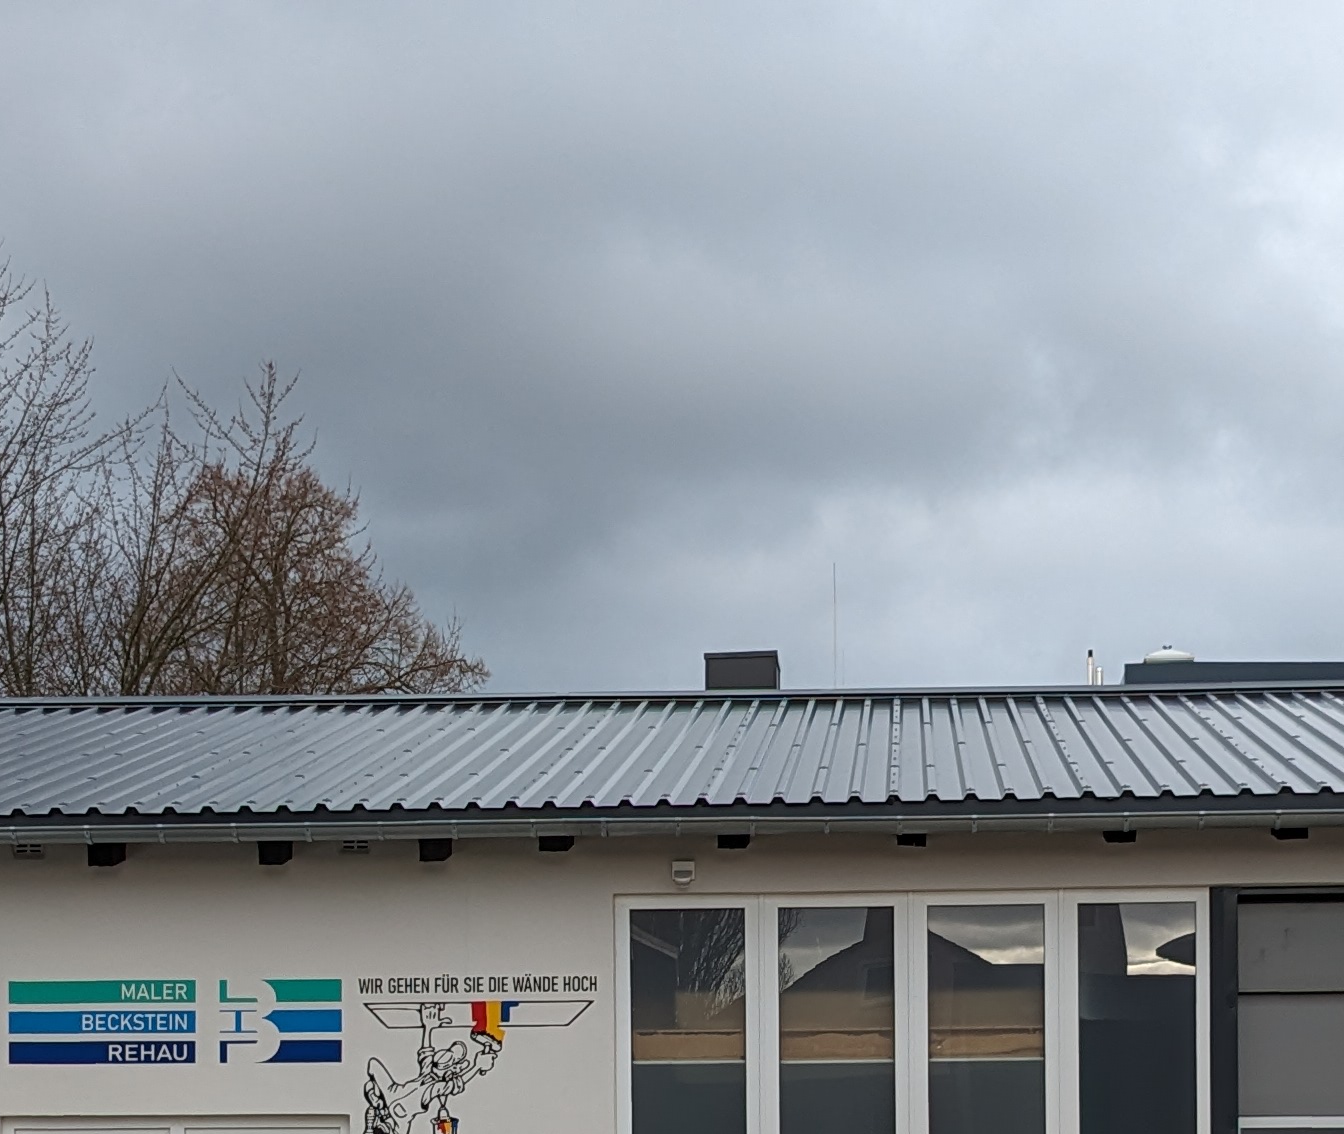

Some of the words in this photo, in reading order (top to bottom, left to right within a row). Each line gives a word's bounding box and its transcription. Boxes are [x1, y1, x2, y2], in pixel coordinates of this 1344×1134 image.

[120, 983, 188, 1000] MALER
[358, 977, 383, 994] WIR
[388, 977, 430, 994] GEHEN
[434, 974, 459, 994] FÜR
[463, 976, 485, 993] SIE
[488, 976, 509, 993] DIE
[512, 973, 559, 993] WÄNDE
[563, 976, 598, 992] HOCH
[81, 1013, 188, 1031] BECKSTEIN
[108, 1043, 188, 1061] REHAU
